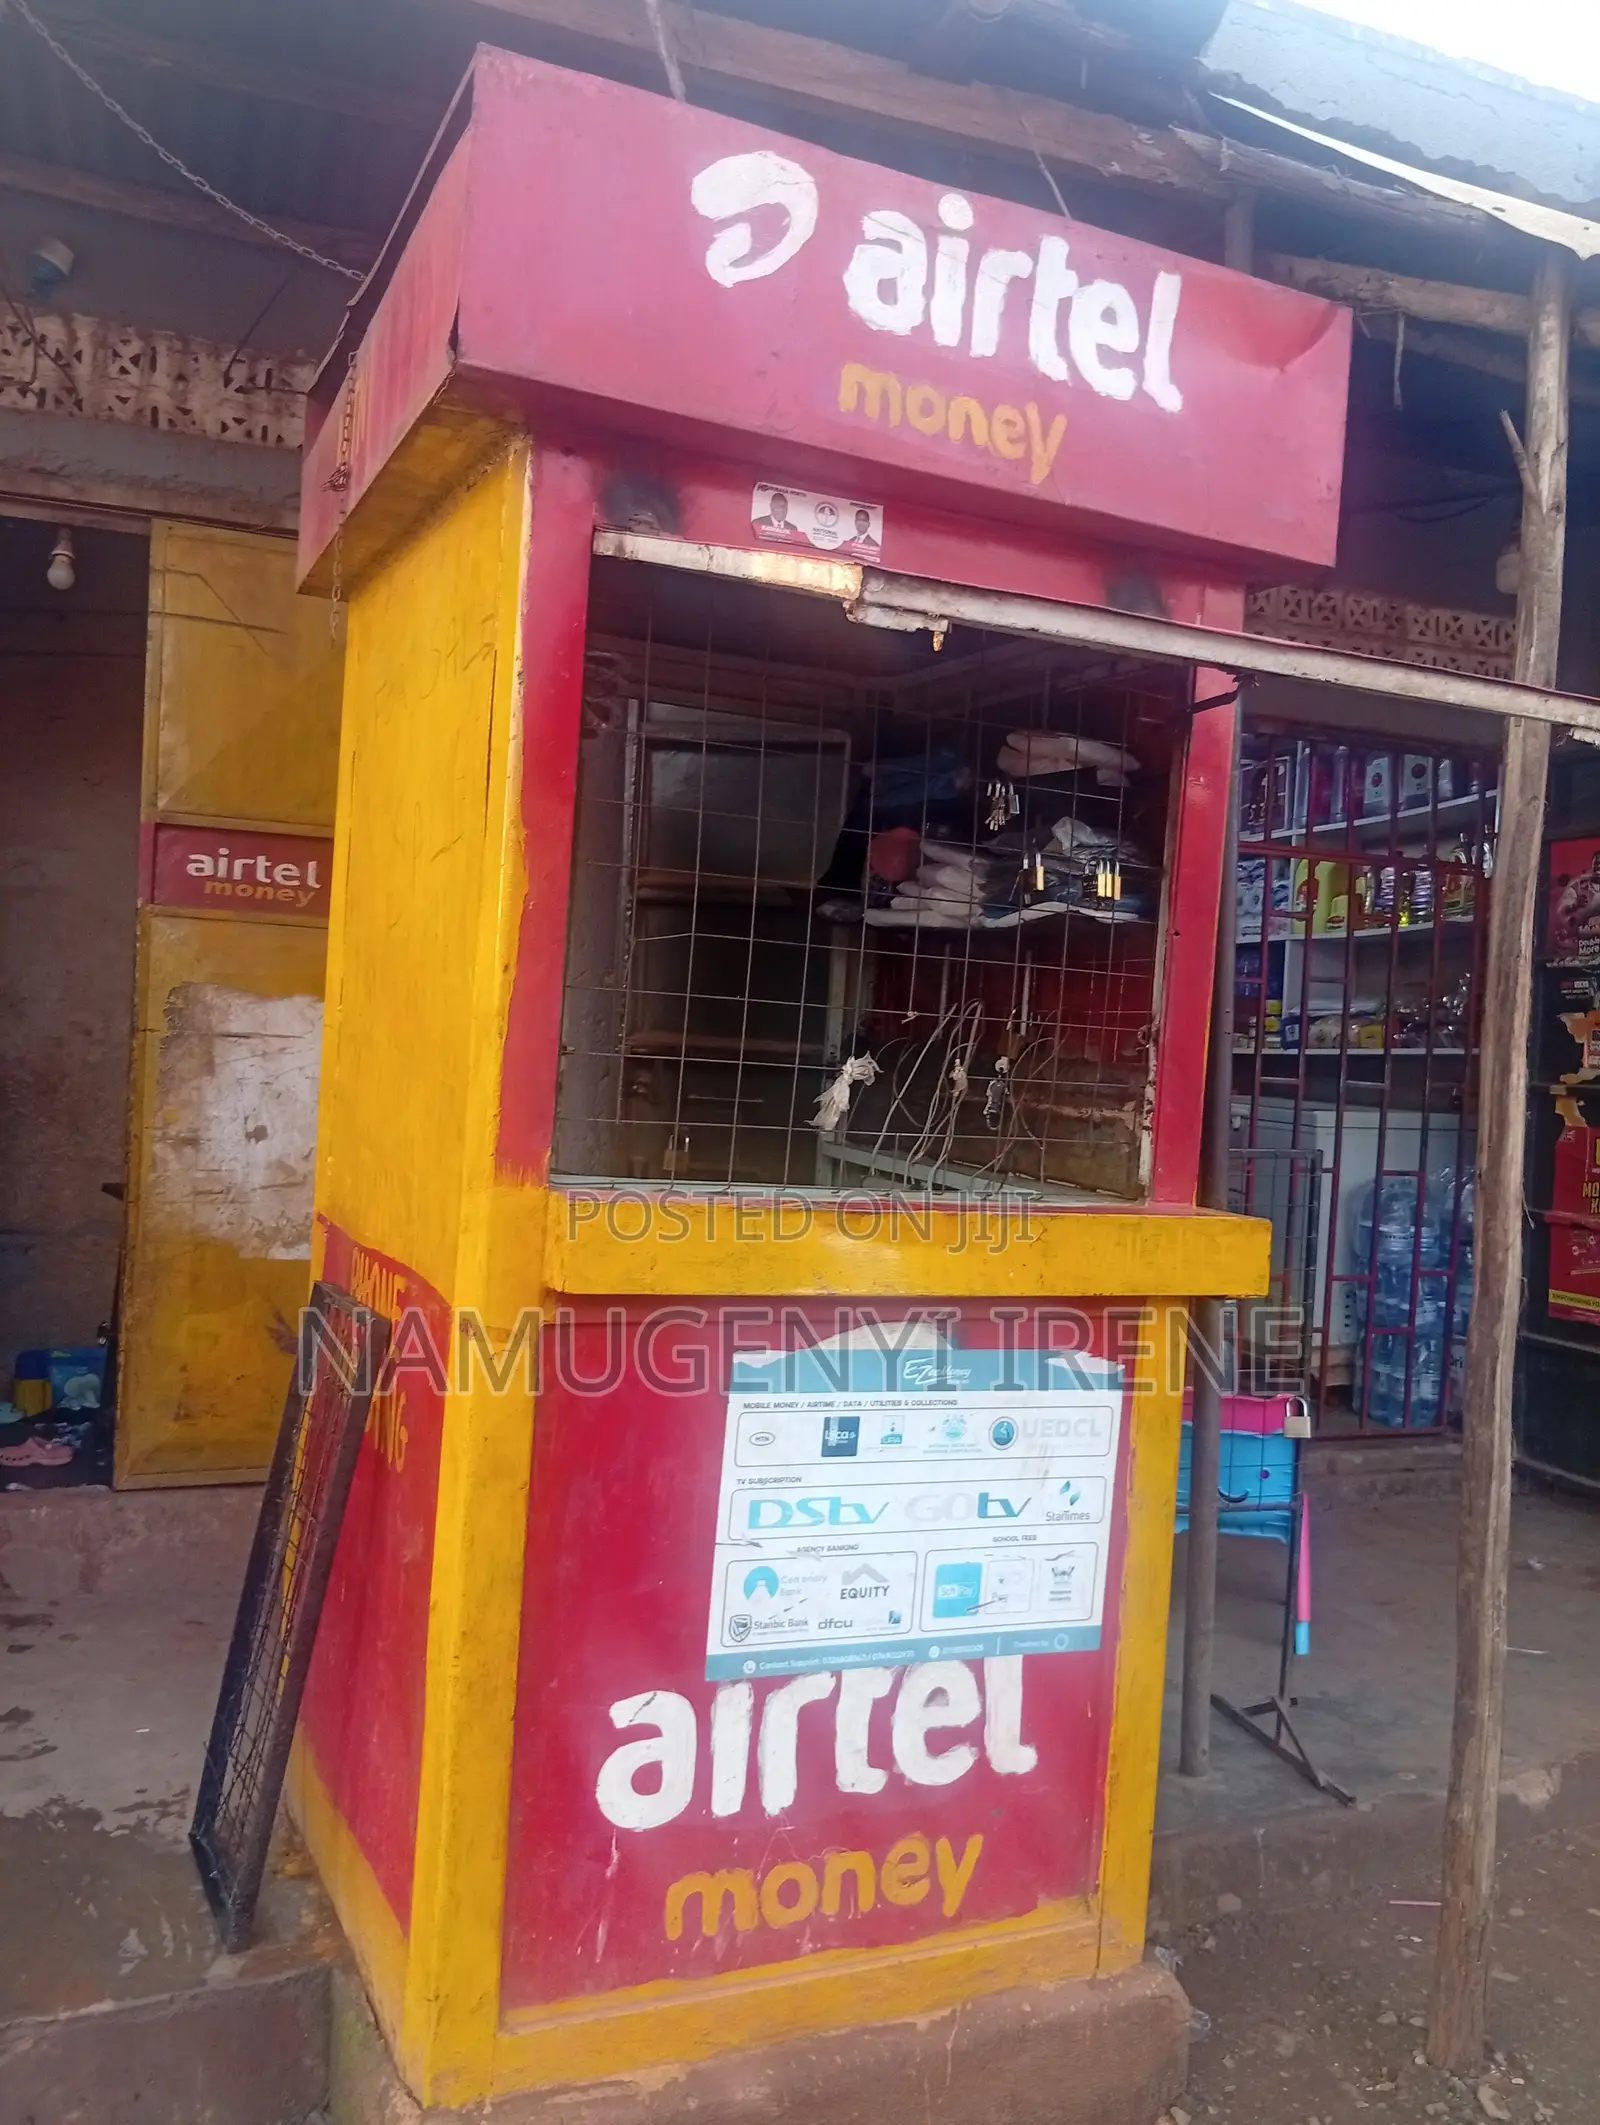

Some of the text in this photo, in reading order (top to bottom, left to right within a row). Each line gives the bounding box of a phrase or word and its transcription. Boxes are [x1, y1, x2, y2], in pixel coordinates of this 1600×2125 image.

[843, 193, 1183, 413] airtel
[838, 363, 1067, 484] money
[186, 848, 322, 888] airtel
[203, 881, 316, 908] money
[843, 1400, 862, 1408] DATA
[1022, 1418, 1101, 1438] UEDCL
[748, 1476, 802, 1484] SUBSCRIPTION
[747, 1496, 889, 1530] DStv
[1045, 1510, 1090, 1521] StarTimes
[840, 1585, 890, 1600] EQUITY
[753, 1617, 809, 1630] Stanbic Bank
[818, 1618, 854, 1630] dfcu
[595, 1655, 1038, 1832] airtel
[665, 1832, 984, 1942] money
